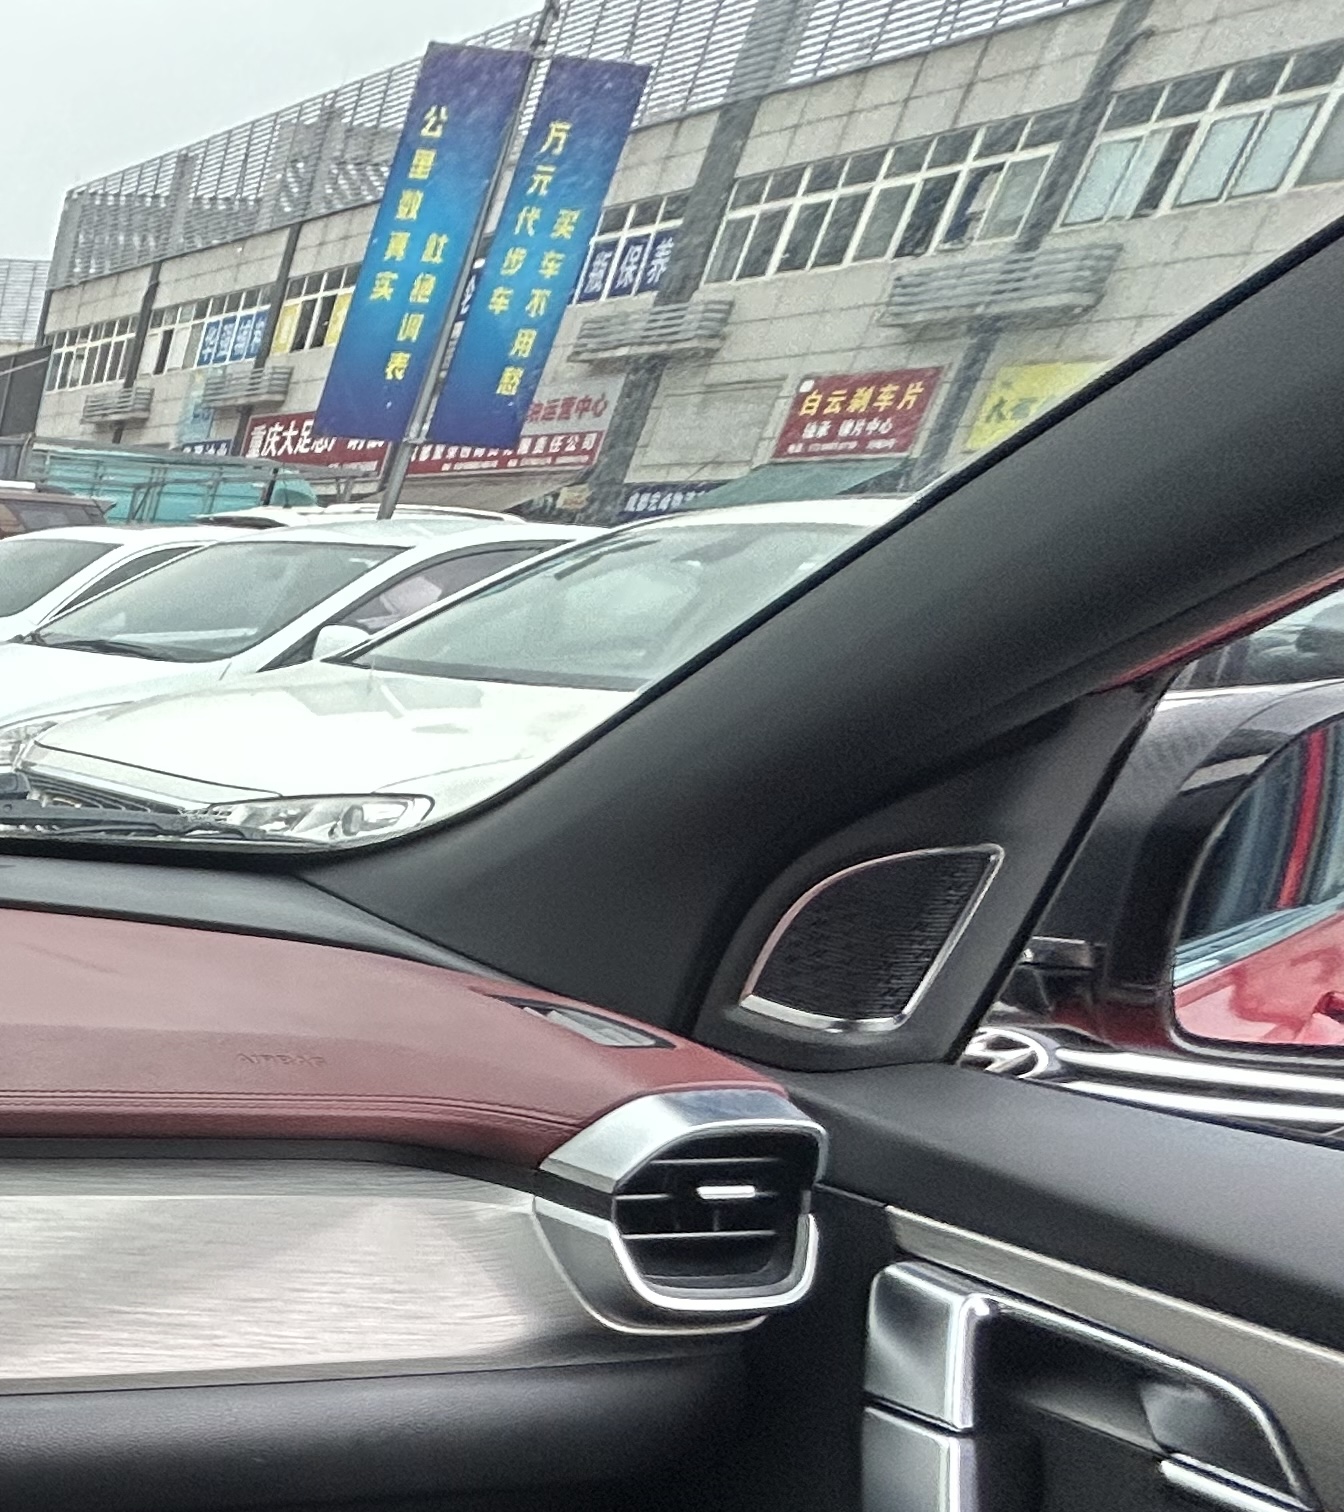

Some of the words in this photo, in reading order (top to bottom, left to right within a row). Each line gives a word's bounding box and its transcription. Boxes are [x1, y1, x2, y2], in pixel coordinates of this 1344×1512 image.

[370, 105, 448, 302] 公里数真实
[488, 121, 573, 315] 万元代步车
[384, 233, 450, 381] 杜绝调表
[497, 209, 582, 396] 买车不用愁
[799, 381, 924, 417] 白云刹车片
